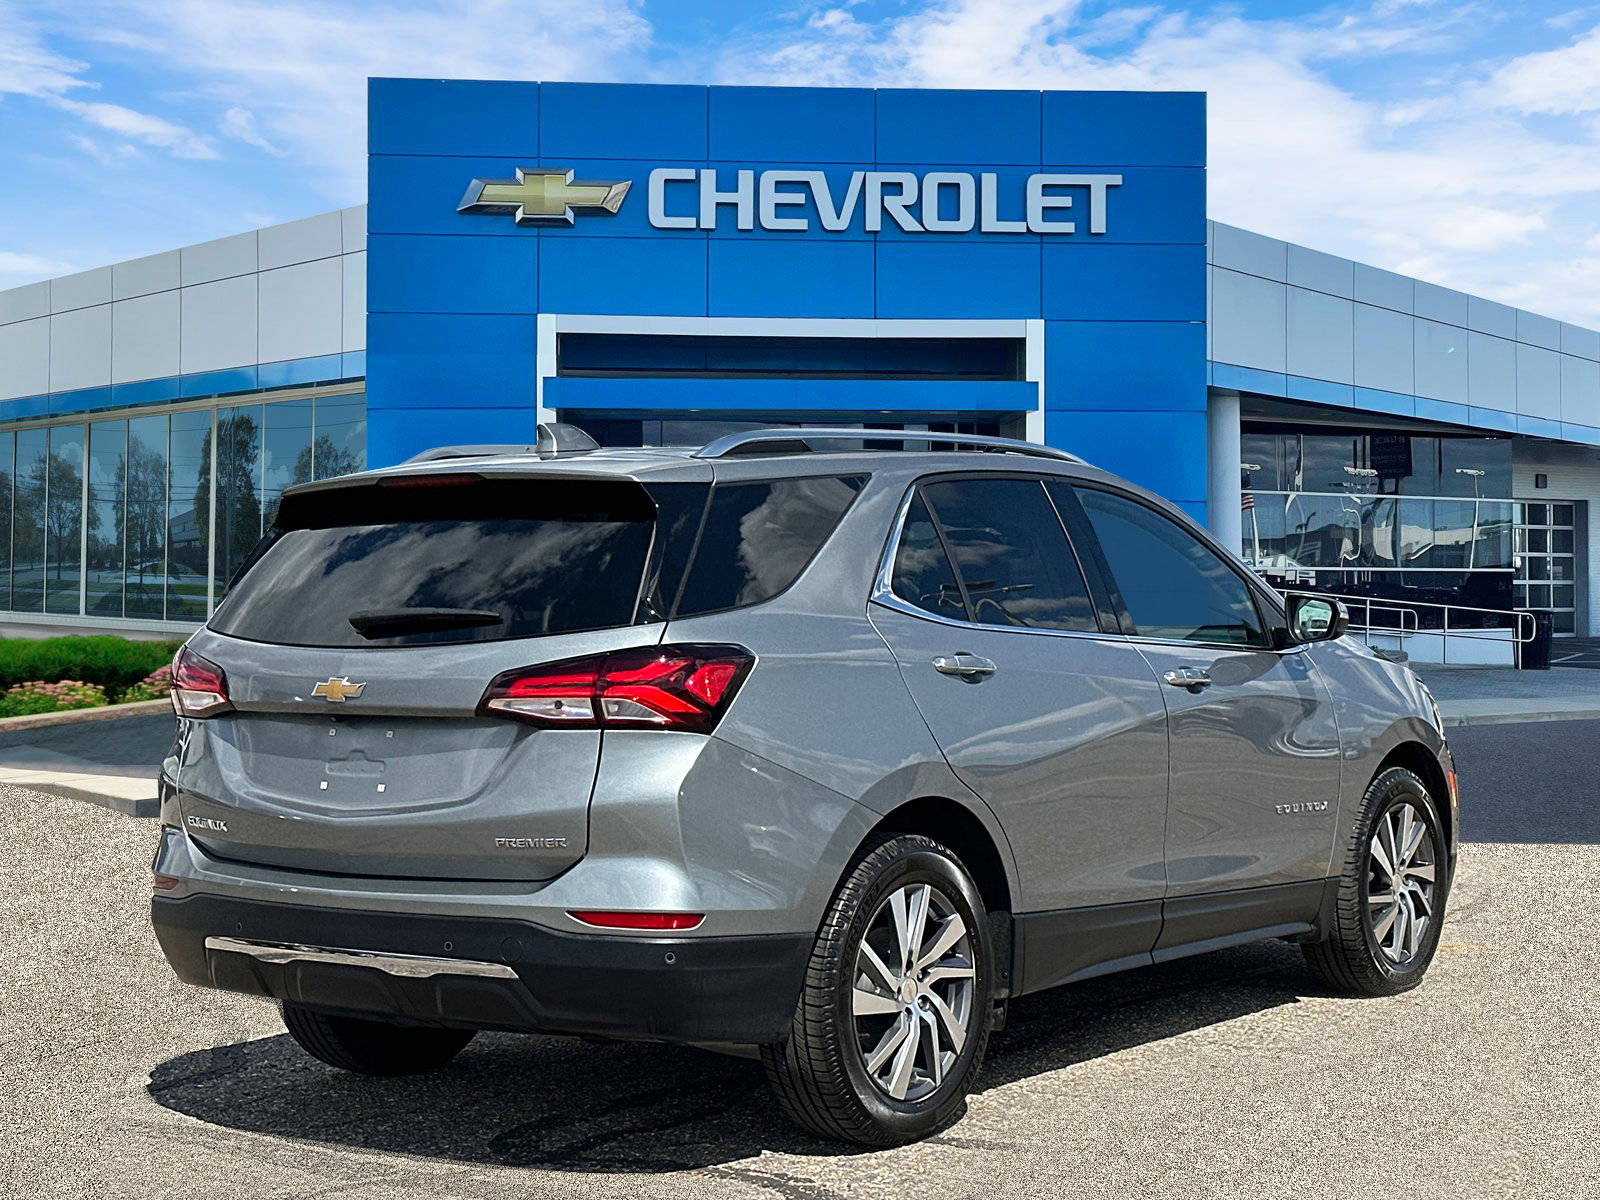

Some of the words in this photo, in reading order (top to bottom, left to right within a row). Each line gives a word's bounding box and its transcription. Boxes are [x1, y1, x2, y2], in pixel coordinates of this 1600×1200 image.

[648, 168, 1123, 234] CHEVROLET
[1275, 800, 1329, 814] EQUINOX
[187, 815, 228, 832] EQUINOX
[495, 837, 567, 848] PREMIER
